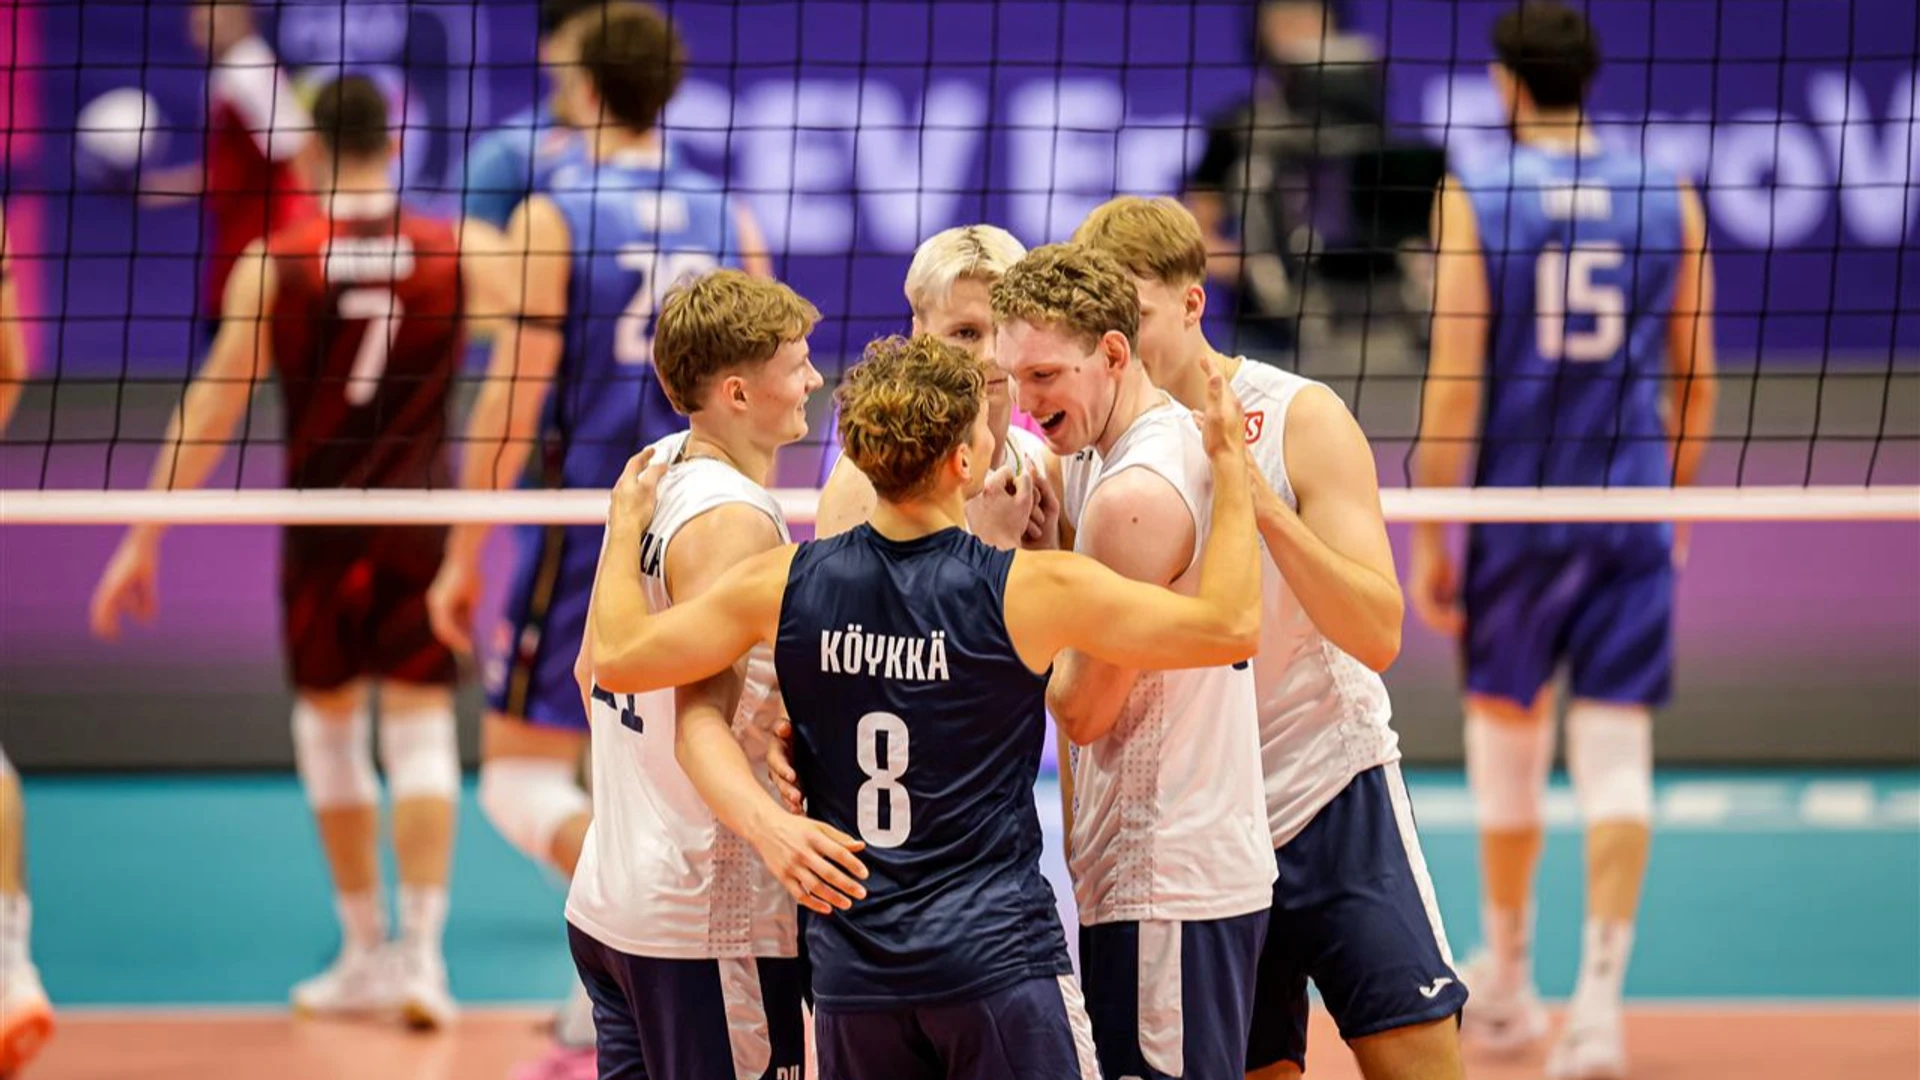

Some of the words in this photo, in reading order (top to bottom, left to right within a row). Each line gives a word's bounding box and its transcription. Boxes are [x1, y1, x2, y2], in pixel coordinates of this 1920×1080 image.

[337, 287, 404, 406] 7
[1536, 240, 1625, 362] 15
[820, 623, 950, 681] KÖYKKÄ
[857, 711, 912, 849] 8
